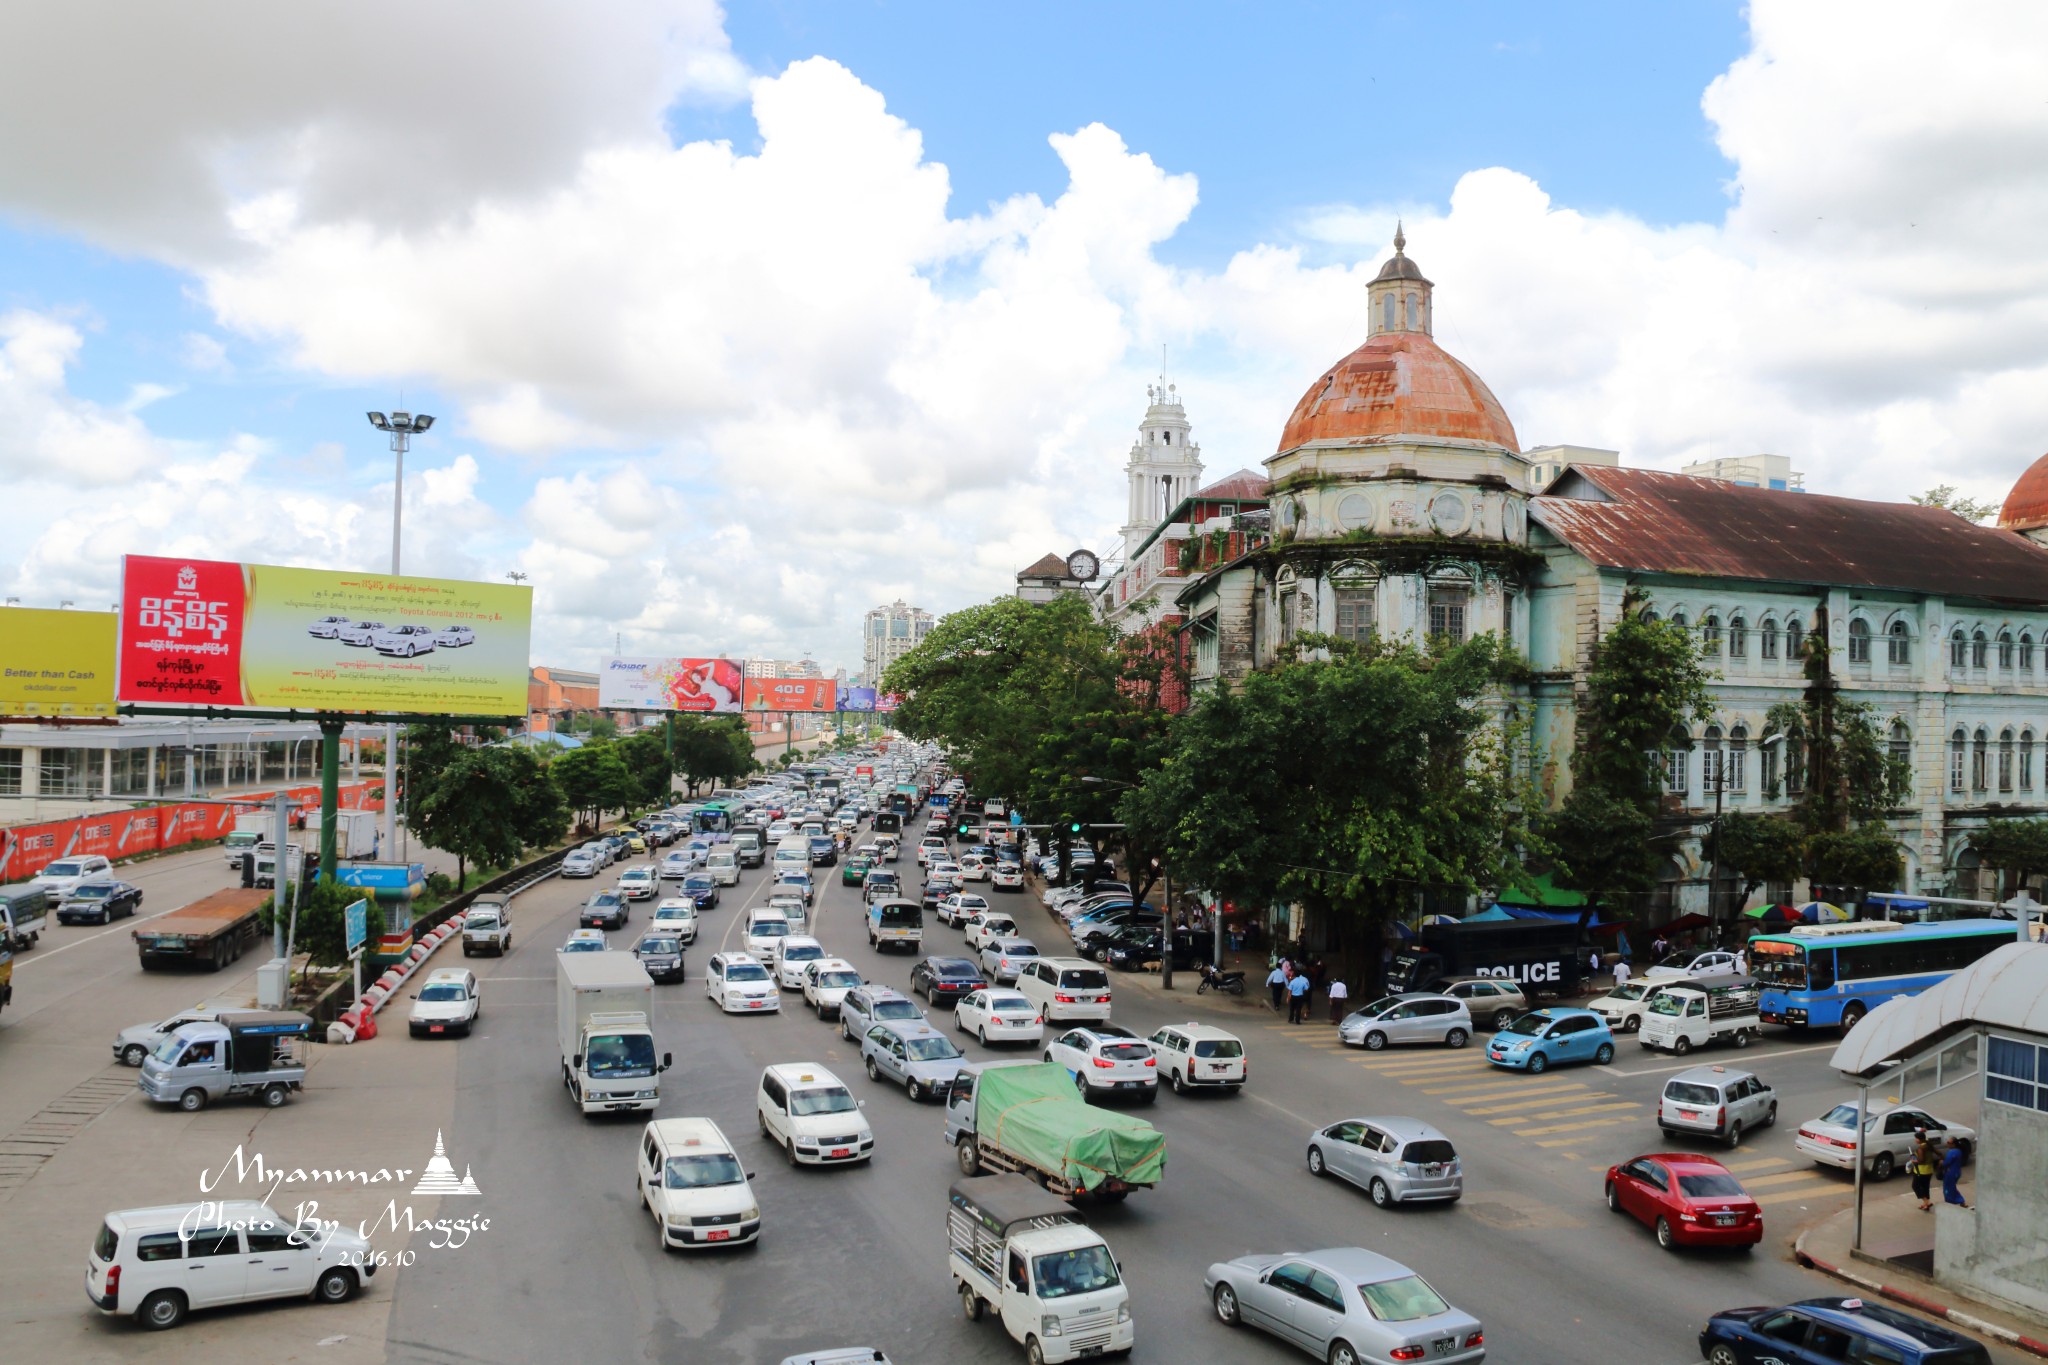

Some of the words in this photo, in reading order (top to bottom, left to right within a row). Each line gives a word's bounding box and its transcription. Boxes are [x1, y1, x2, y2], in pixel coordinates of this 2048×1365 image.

[399, 607, 425, 617] Toyota
[426, 609, 453, 618] Corolla
[455, 611, 474, 619] 2012
[4, 668, 37, 677] Better
[41, 669, 65, 679] than
[68, 670, 95, 679] Cash
[1388, 983, 1404, 993] POLICE
